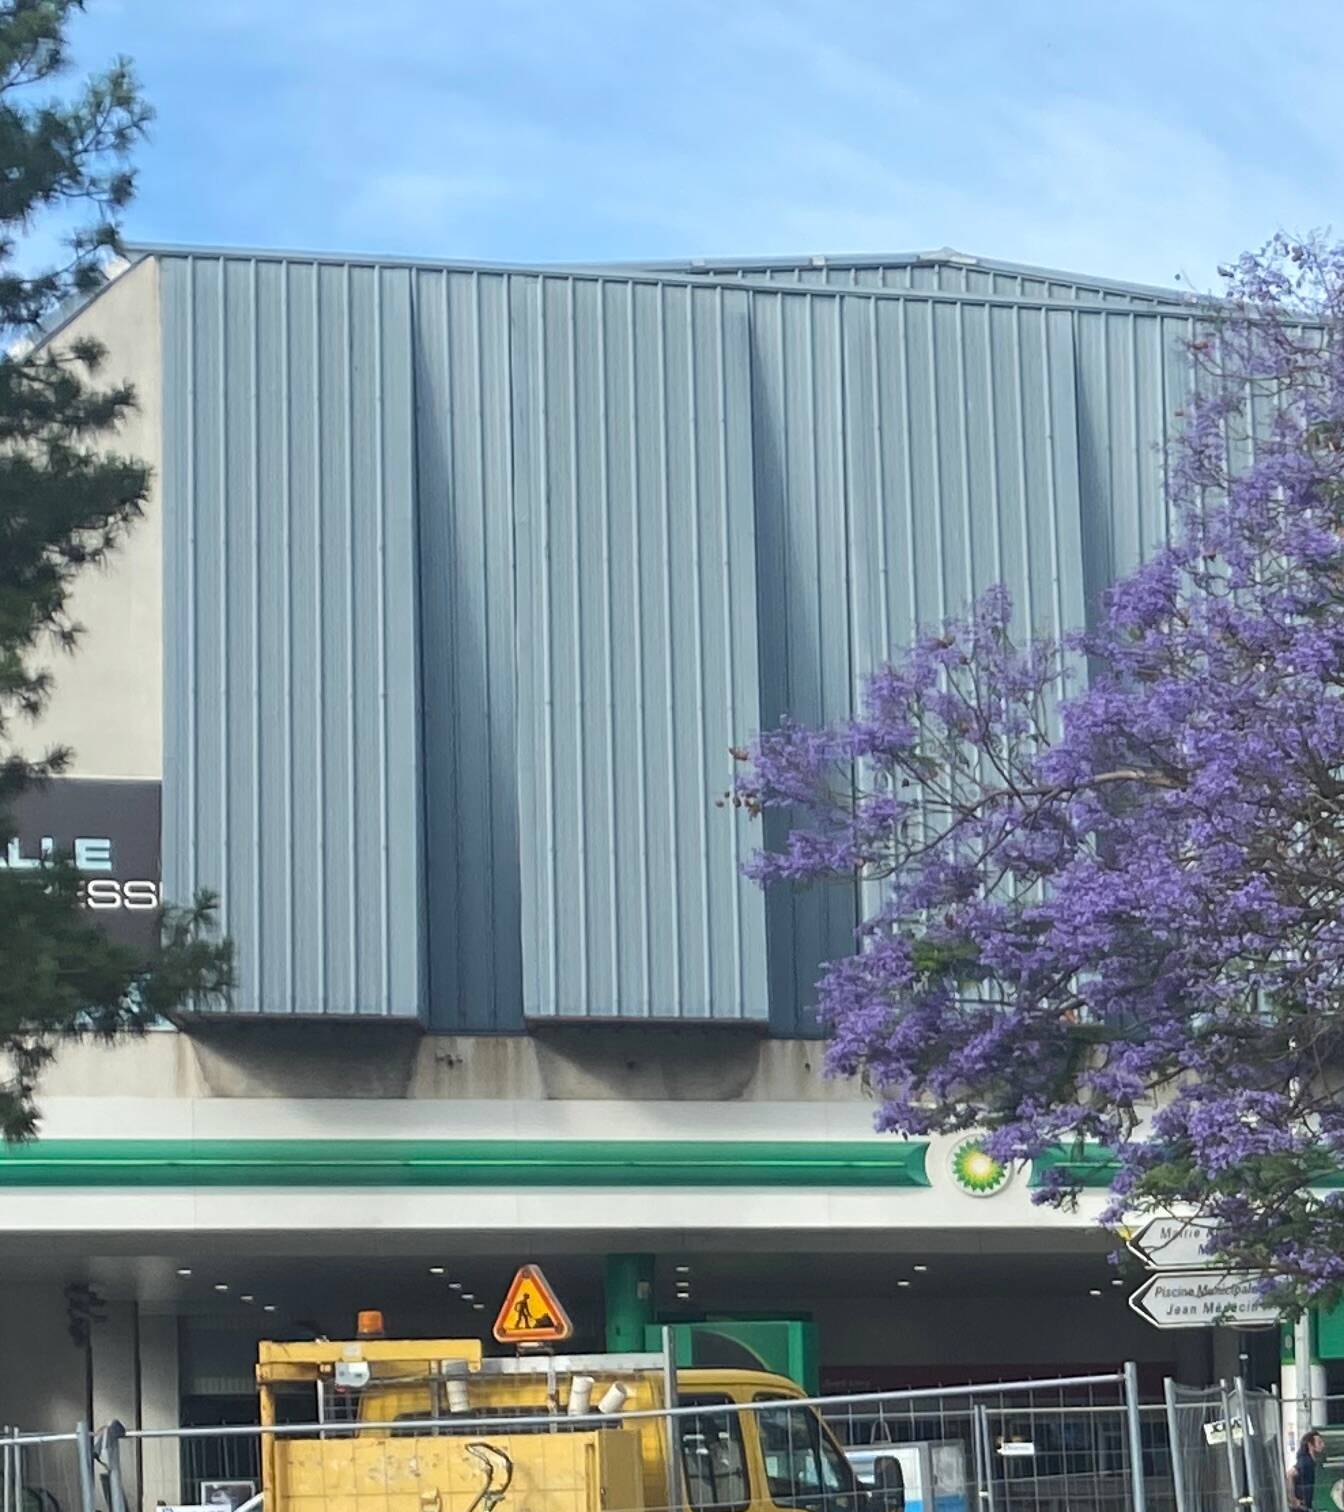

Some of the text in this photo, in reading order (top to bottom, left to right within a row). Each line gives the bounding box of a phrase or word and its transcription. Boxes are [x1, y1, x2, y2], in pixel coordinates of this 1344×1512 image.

[1154, 1283, 1259, 1298] Piscine Municipal
[1166, 1304, 1198, 1316] Jean
